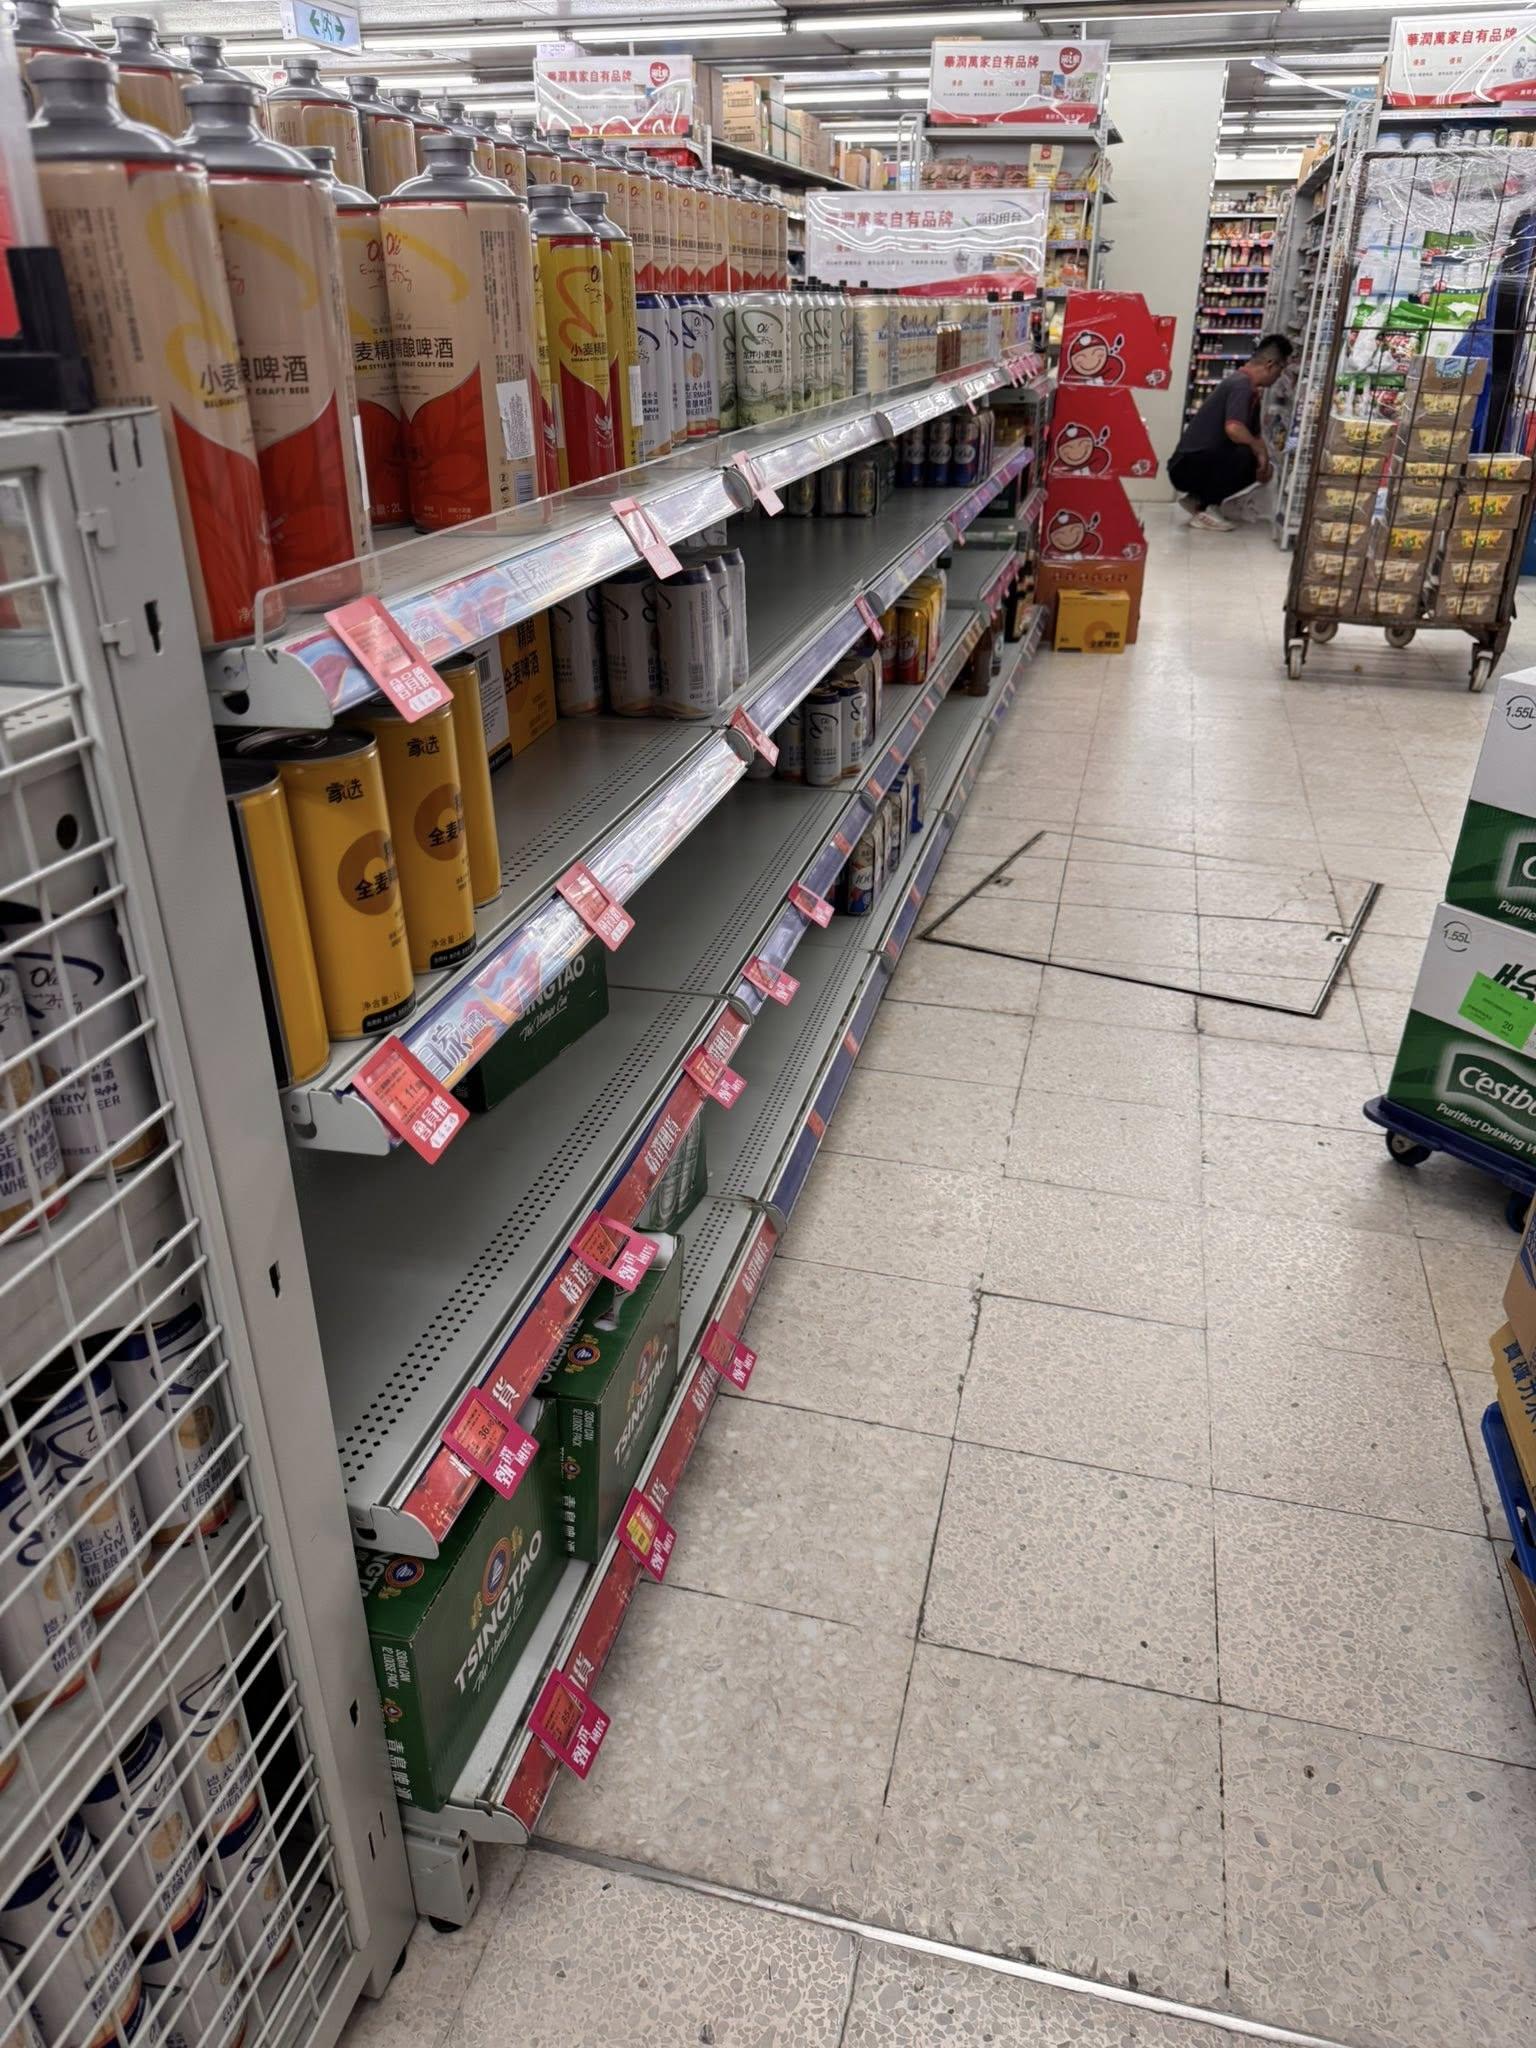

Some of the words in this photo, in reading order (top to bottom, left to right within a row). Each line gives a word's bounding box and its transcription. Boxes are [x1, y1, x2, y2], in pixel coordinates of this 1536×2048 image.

[1442, 929, 1472, 944] 1.55L
[1436, 1101, 1480, 1128] Purified
[1478, 1121, 1525, 1151] Drinking
[614, 1343, 668, 1466] TSINGTAO
[453, 1529, 543, 1696] TSINGTAO
